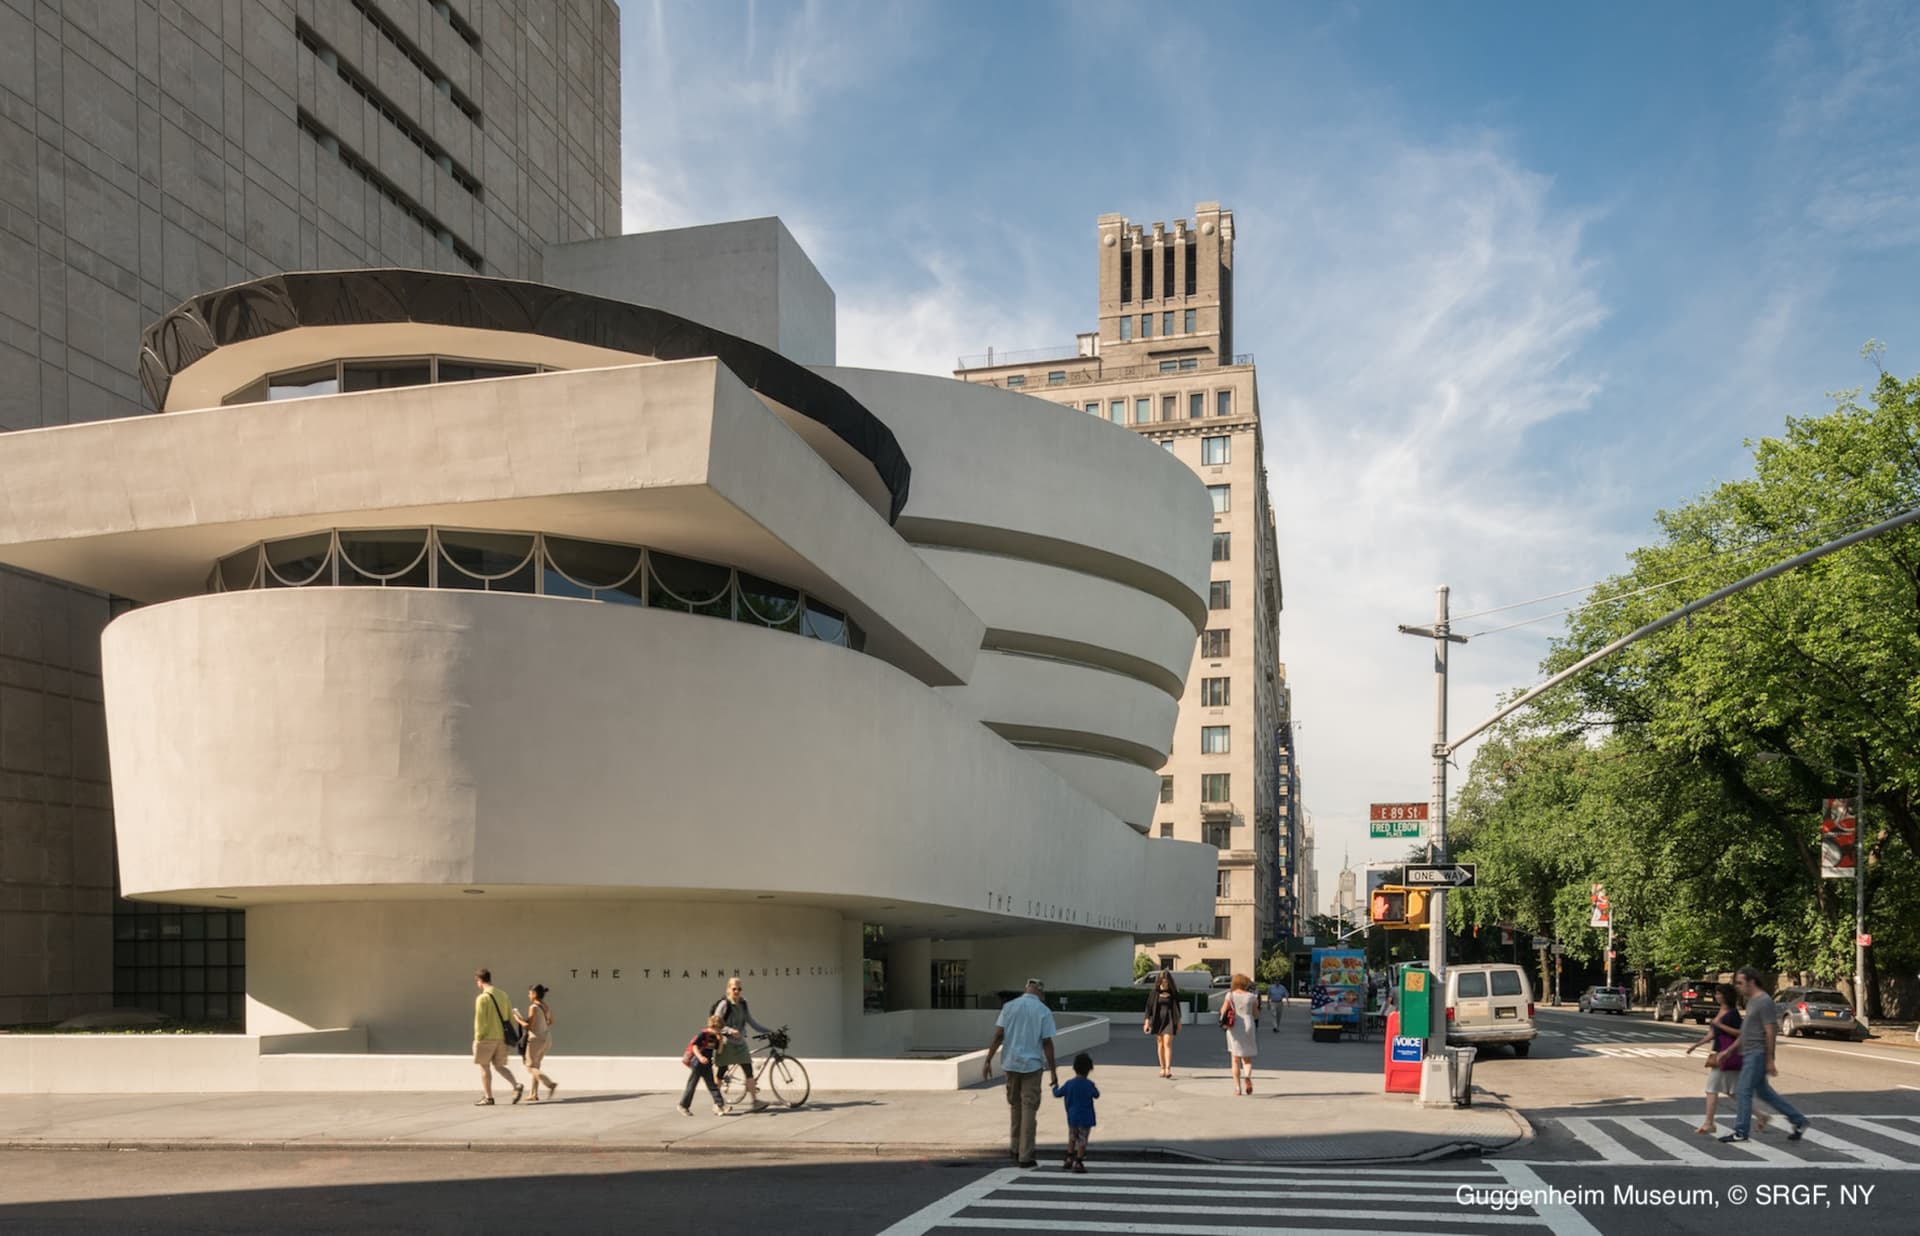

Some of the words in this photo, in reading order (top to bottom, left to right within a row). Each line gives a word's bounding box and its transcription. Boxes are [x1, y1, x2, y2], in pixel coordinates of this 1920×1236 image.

[1381, 807, 1387, 819] E
[1391, 807, 1403, 819] 89
[1408, 806, 1418, 819] St
[1371, 823, 1391, 832] FRED
[1414, 871, 1435, 881] ONE
[1443, 871, 1465, 881] WAY
[571, 968, 621, 979] THE
[1395, 1036, 1421, 1047] VOICE
